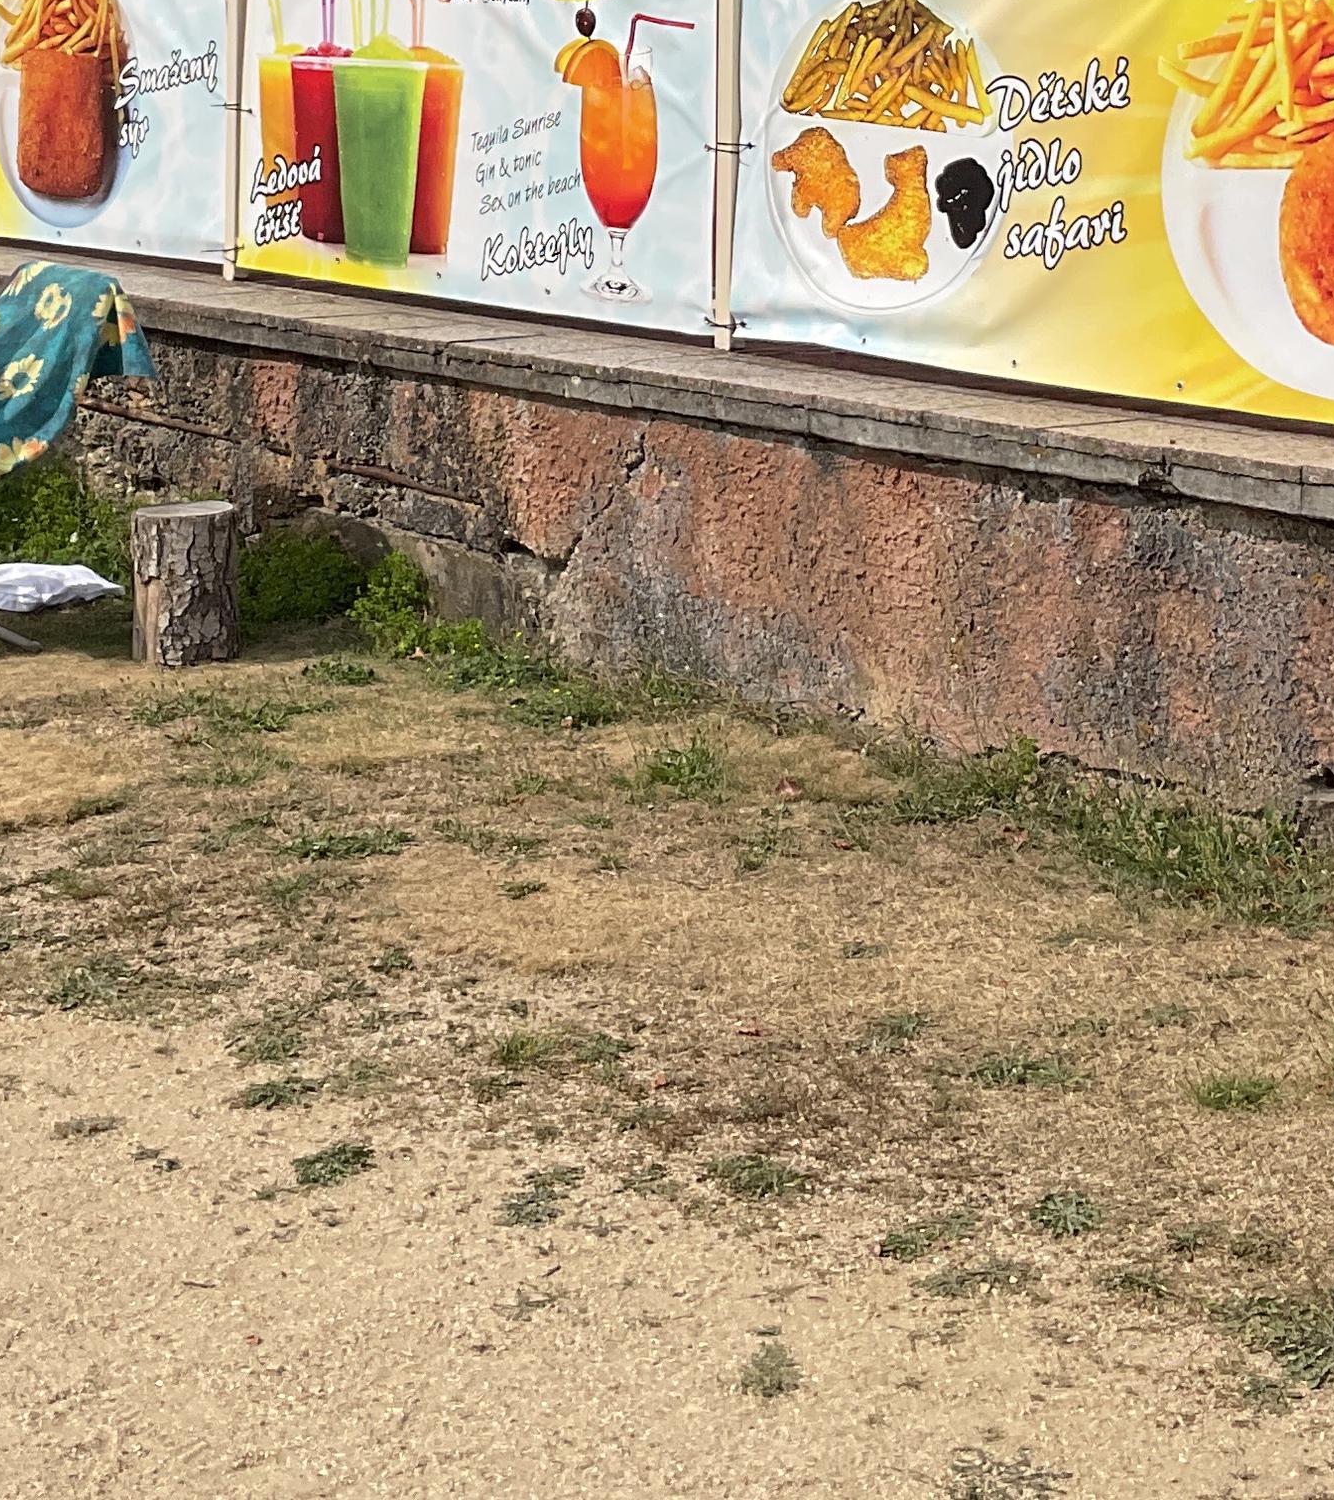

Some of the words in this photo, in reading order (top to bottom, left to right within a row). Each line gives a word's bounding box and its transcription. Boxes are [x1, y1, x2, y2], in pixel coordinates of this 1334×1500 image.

[114, 40, 218, 110] Smažený
[985, 55, 1132, 132] Dětské
[118, 108, 150, 160] sýr
[471, 125, 509, 154] Tequila
[512, 110, 562, 140] Sunrise
[250, 143, 322, 204] Ledová
[475, 163, 496, 188] Gin
[499, 157, 512, 178] &
[513, 149, 542, 173] tonic
[479, 194, 506, 215] Sex
[508, 190, 521, 208] on
[525, 181, 544, 201] the
[547, 167, 581, 196] beach
[996, 140, 1083, 211] jídlo
[480, 217, 595, 282] Koktejly
[1003, 197, 1128, 271] safari
